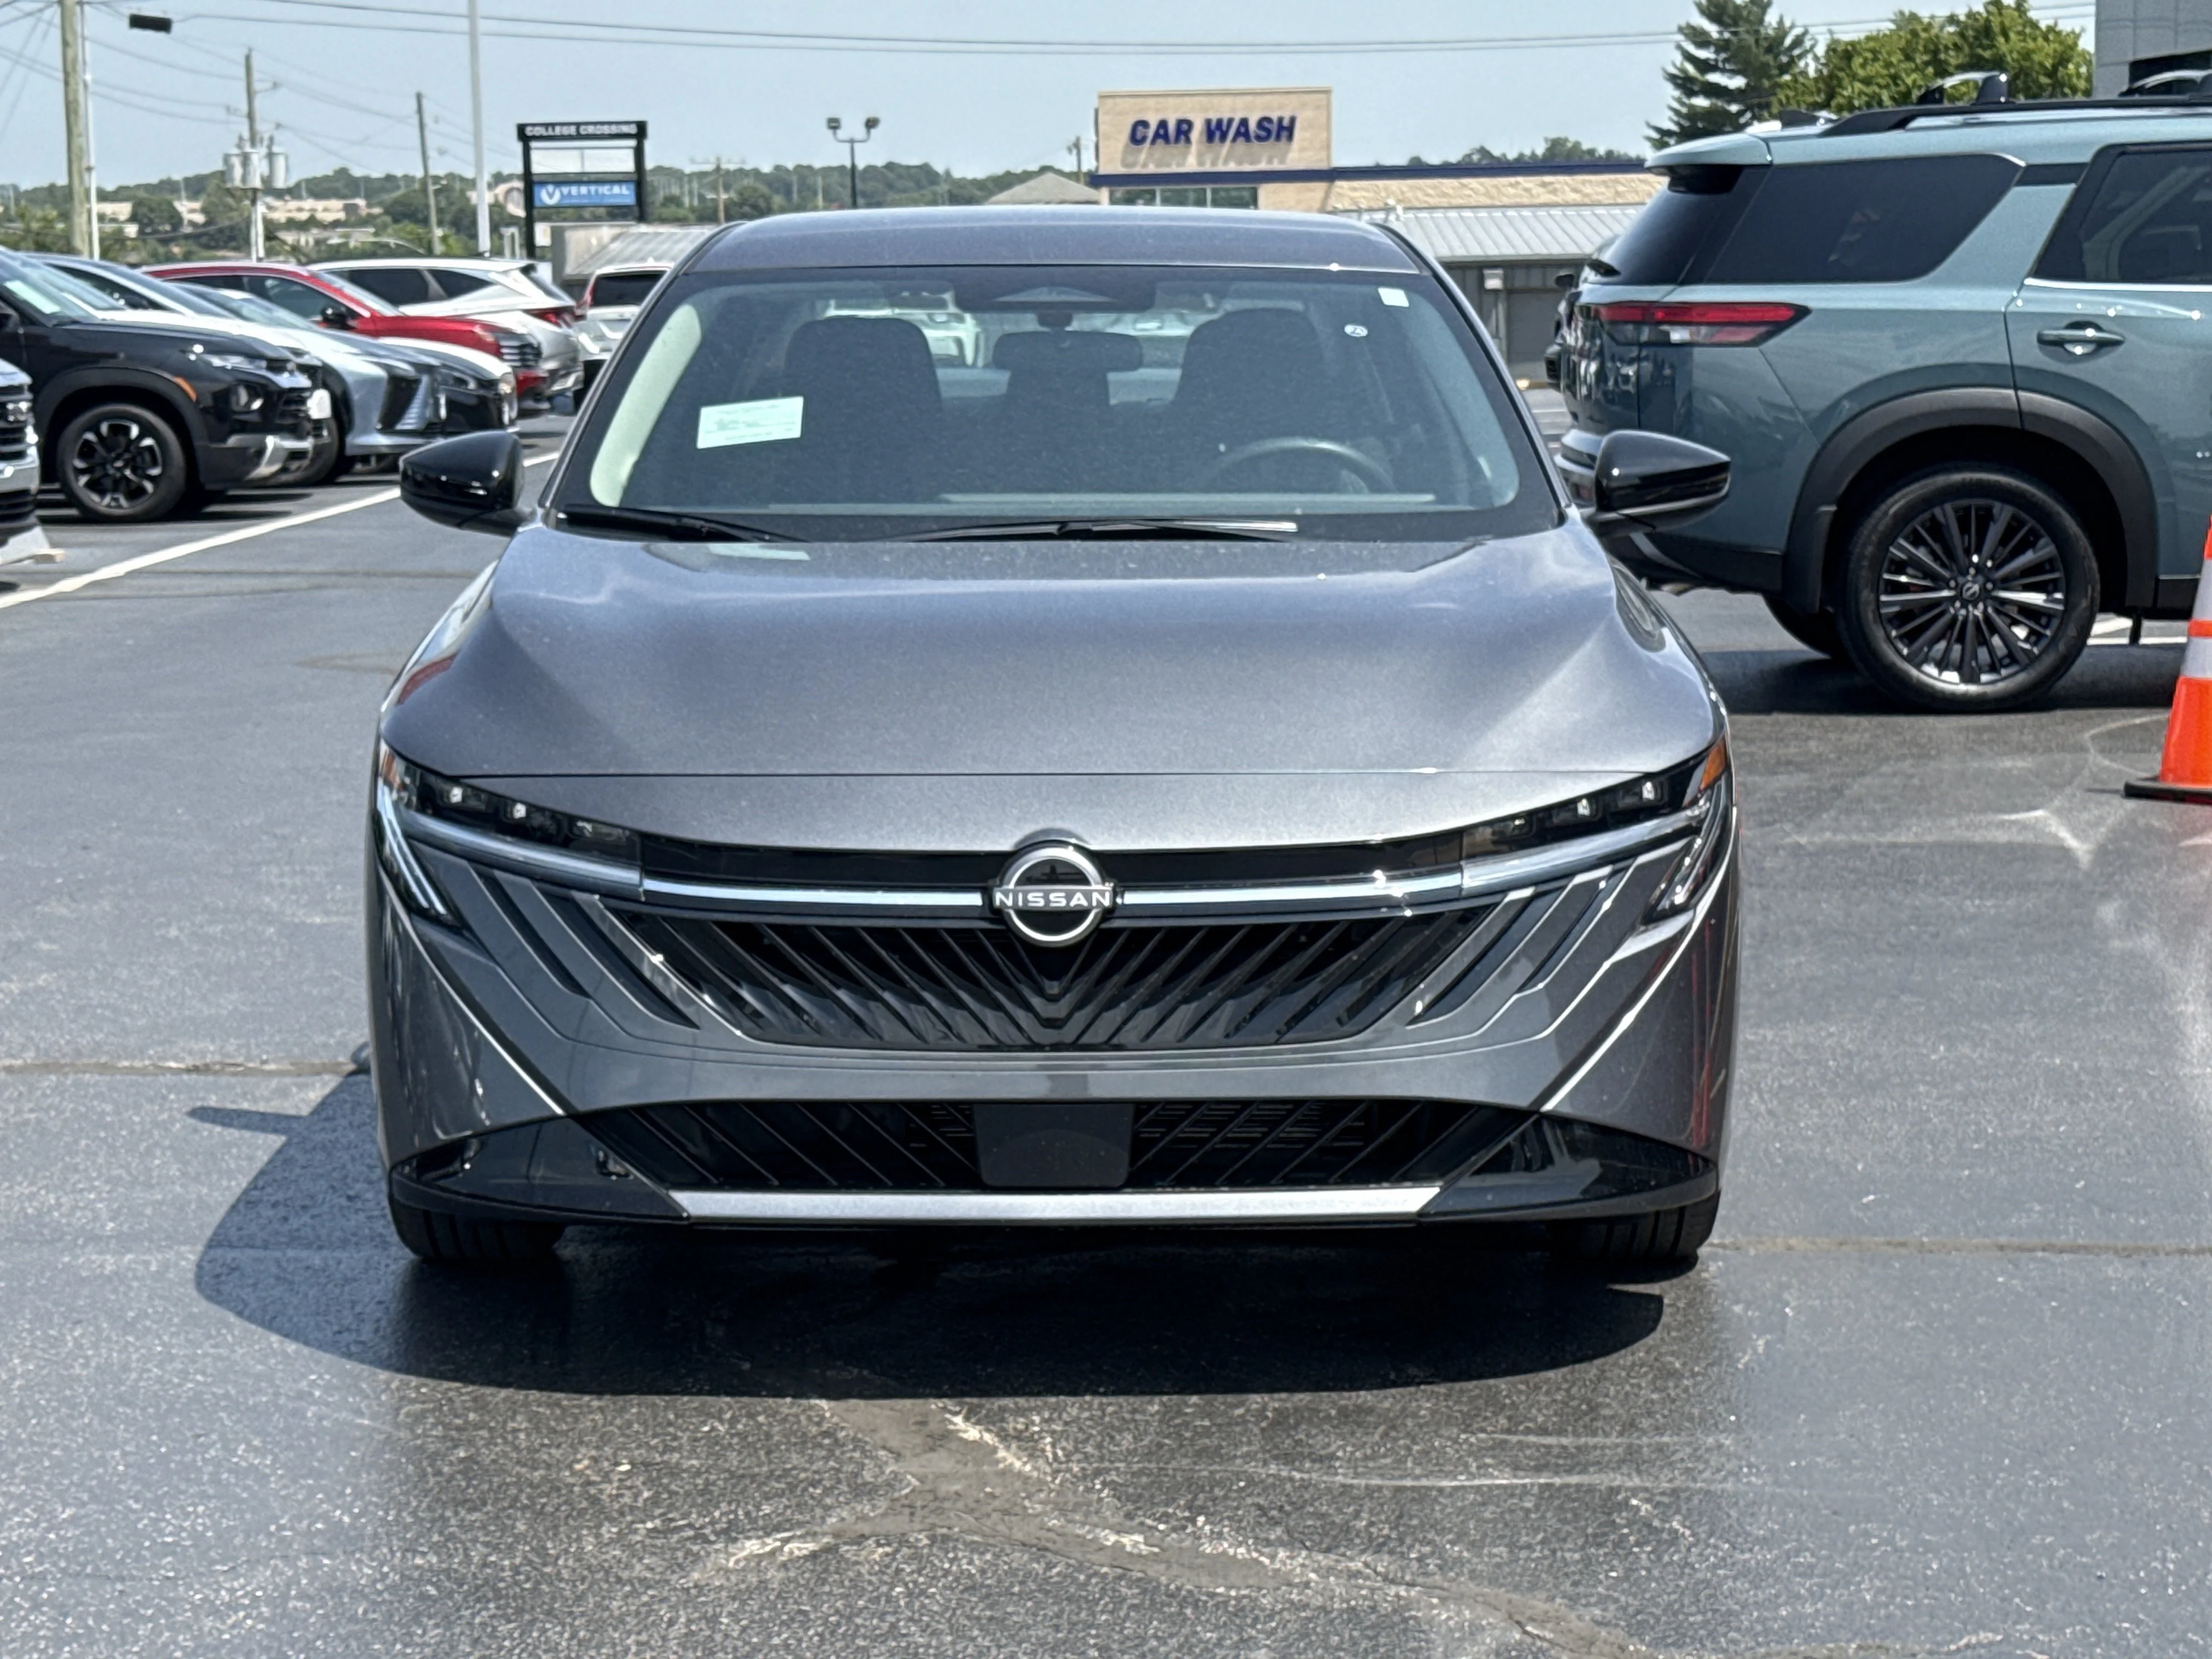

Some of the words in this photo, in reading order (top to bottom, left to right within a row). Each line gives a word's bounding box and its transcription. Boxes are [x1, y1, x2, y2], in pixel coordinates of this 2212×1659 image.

[525, 126, 577, 136] COLLEGE
[579, 123, 637, 134] CROSSING
[1129, 117, 1194, 146] CAR
[1204, 115, 1297, 145] WASH
[561, 184, 630, 196] VERTICAL
[995, 891, 1110, 907] NISSAN
